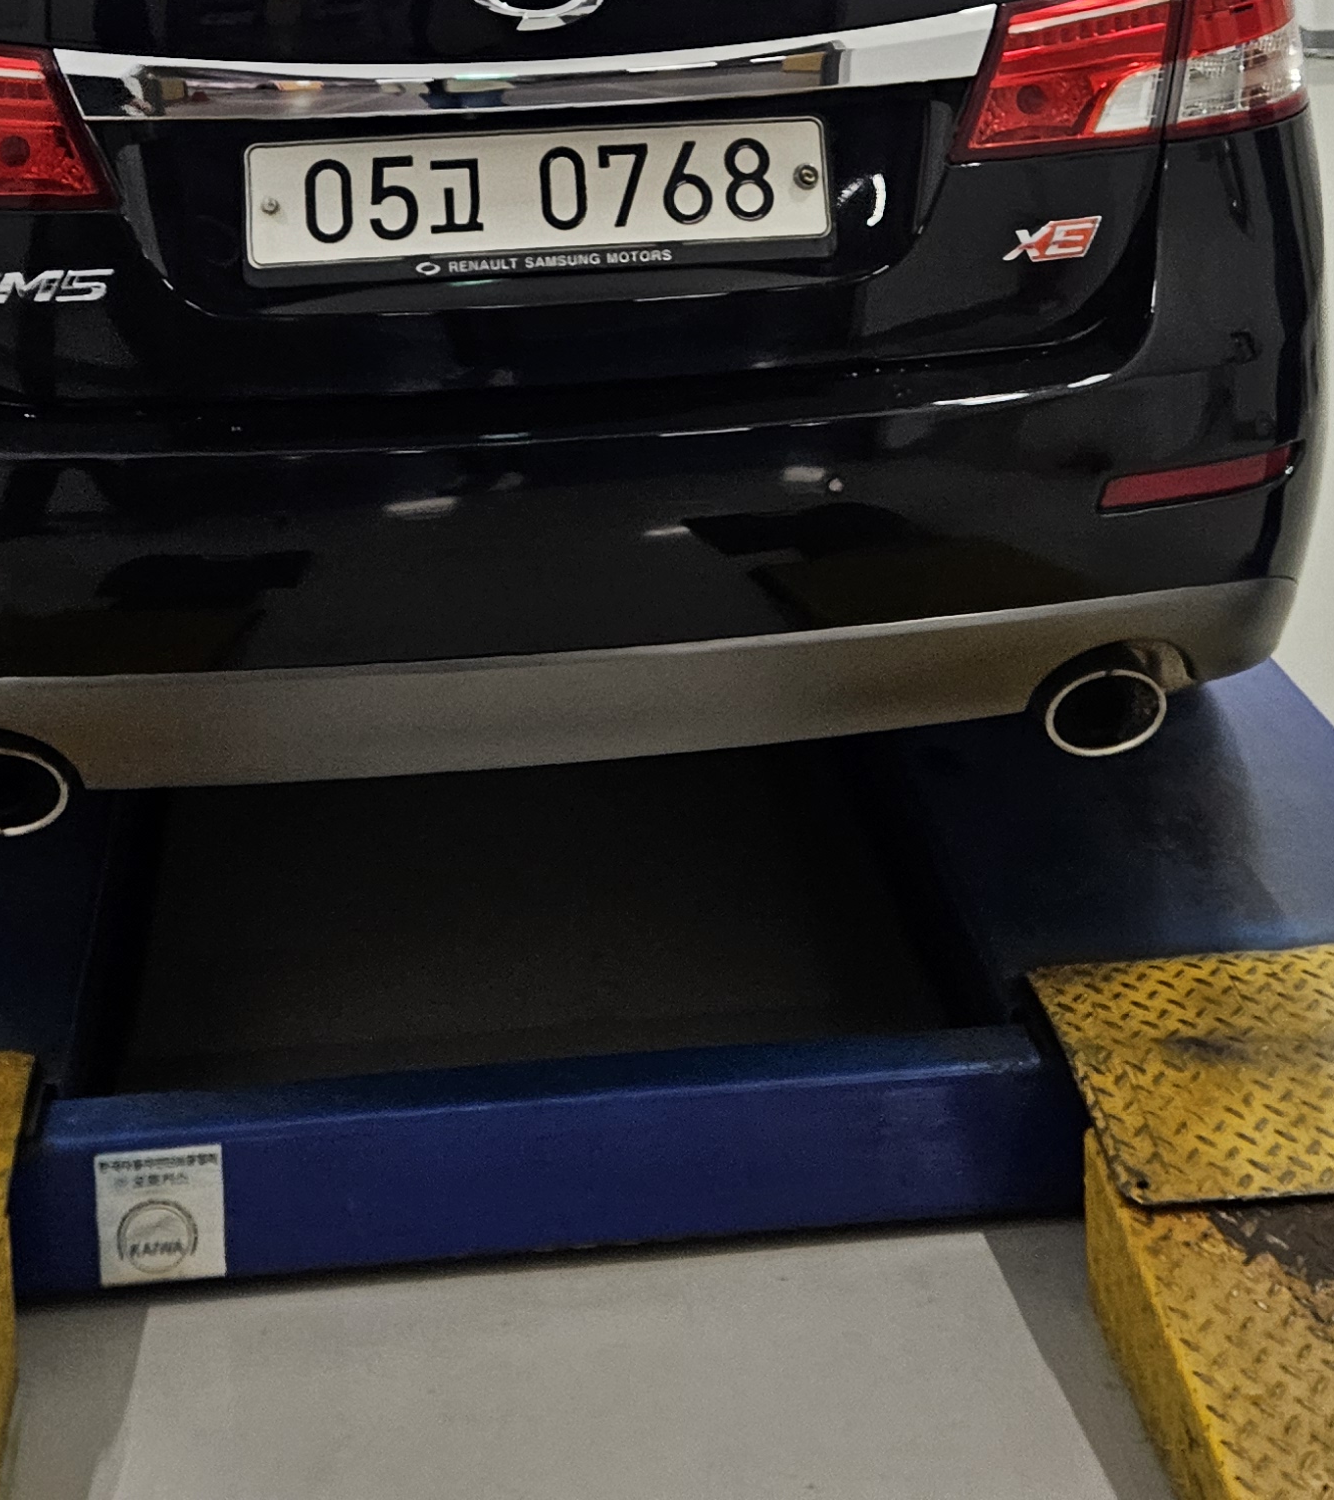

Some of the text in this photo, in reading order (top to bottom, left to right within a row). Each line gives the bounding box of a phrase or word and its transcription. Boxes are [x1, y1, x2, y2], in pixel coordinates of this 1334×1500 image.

[304, 137, 775, 244] 05고 0768
[448, 248, 673, 273] RENAULT SAMSUNG MOTORS
